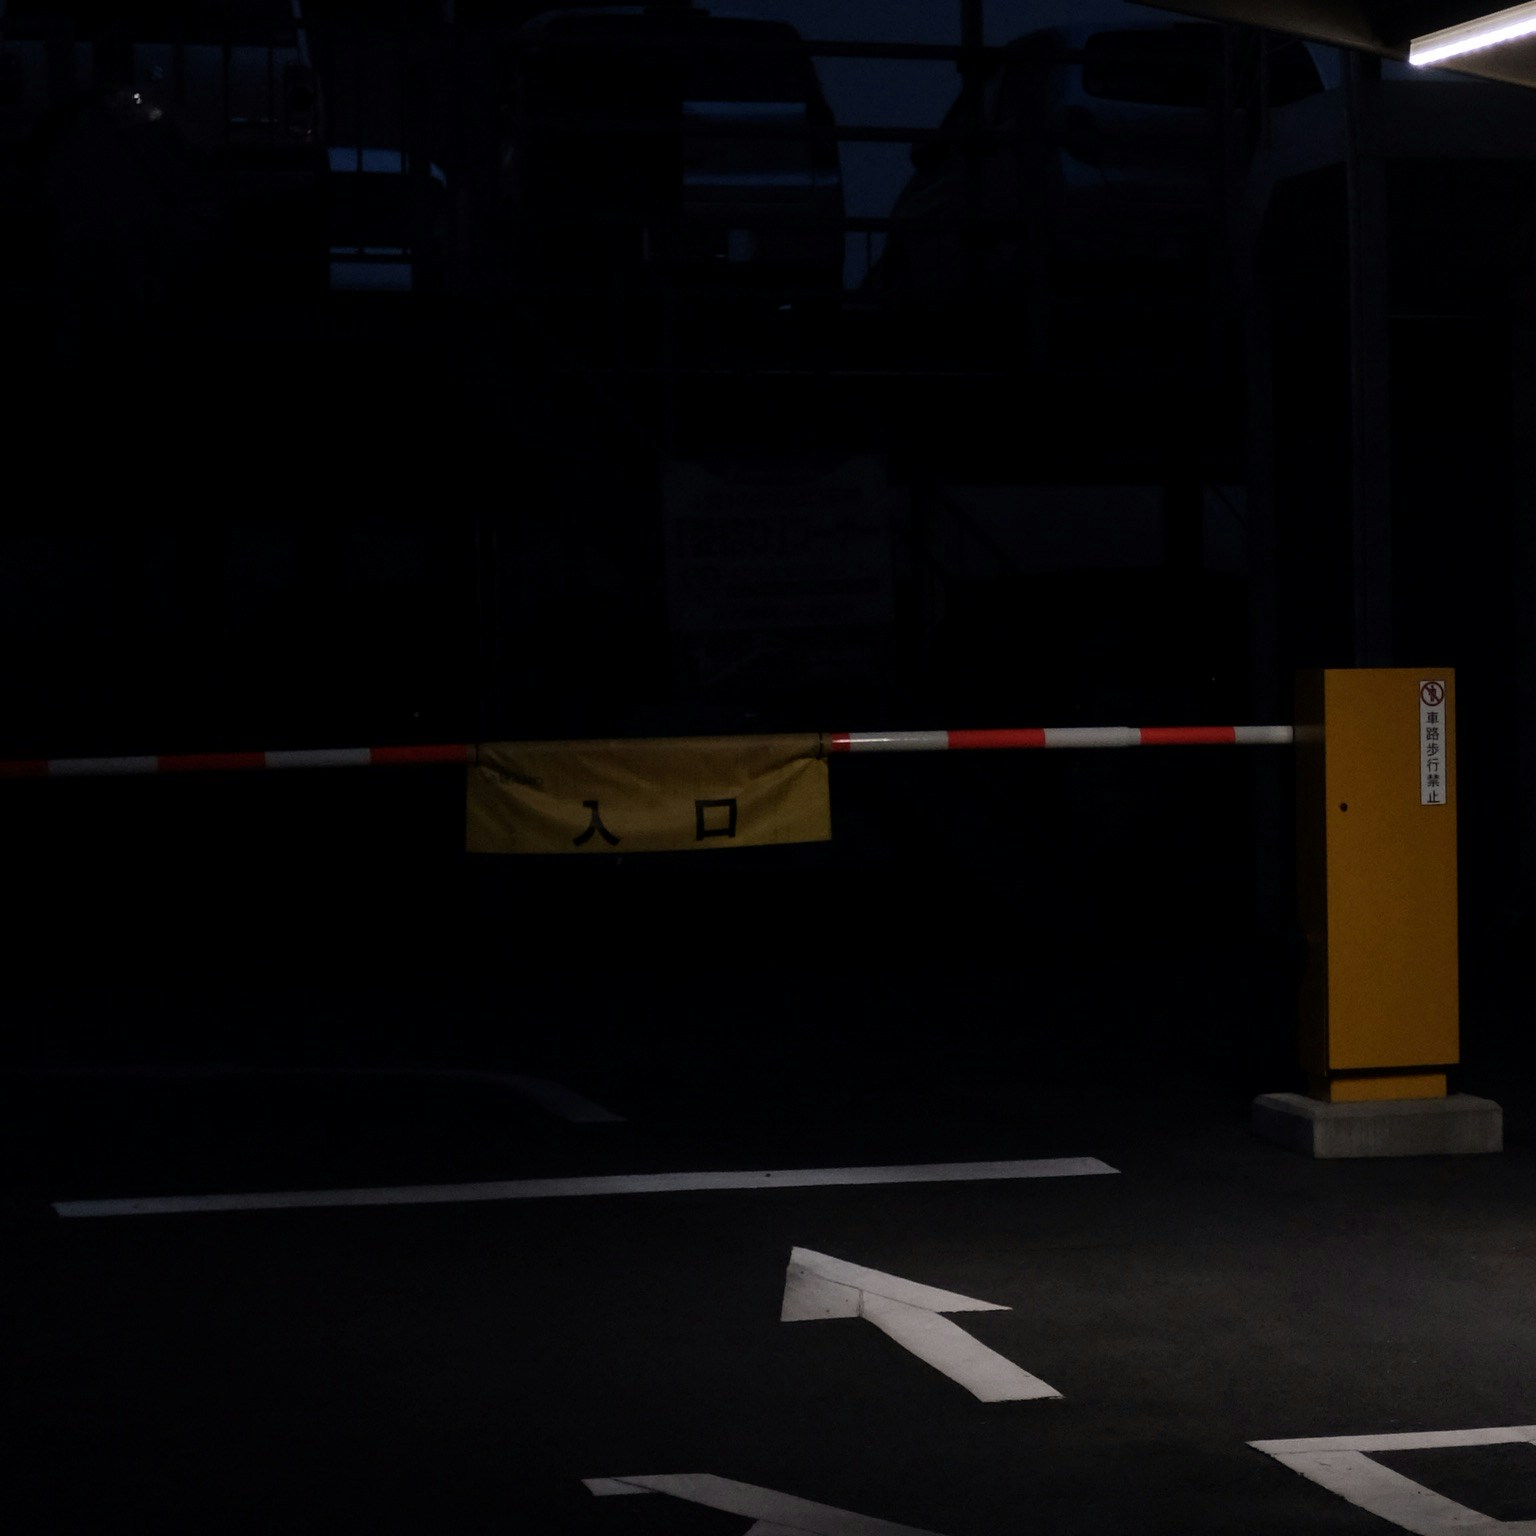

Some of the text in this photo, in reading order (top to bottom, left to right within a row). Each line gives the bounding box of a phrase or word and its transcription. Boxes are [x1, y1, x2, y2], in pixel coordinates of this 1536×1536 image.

[1426, 712, 1440, 803] 車路歩行禁止
[573, 798, 737, 846] 入口
